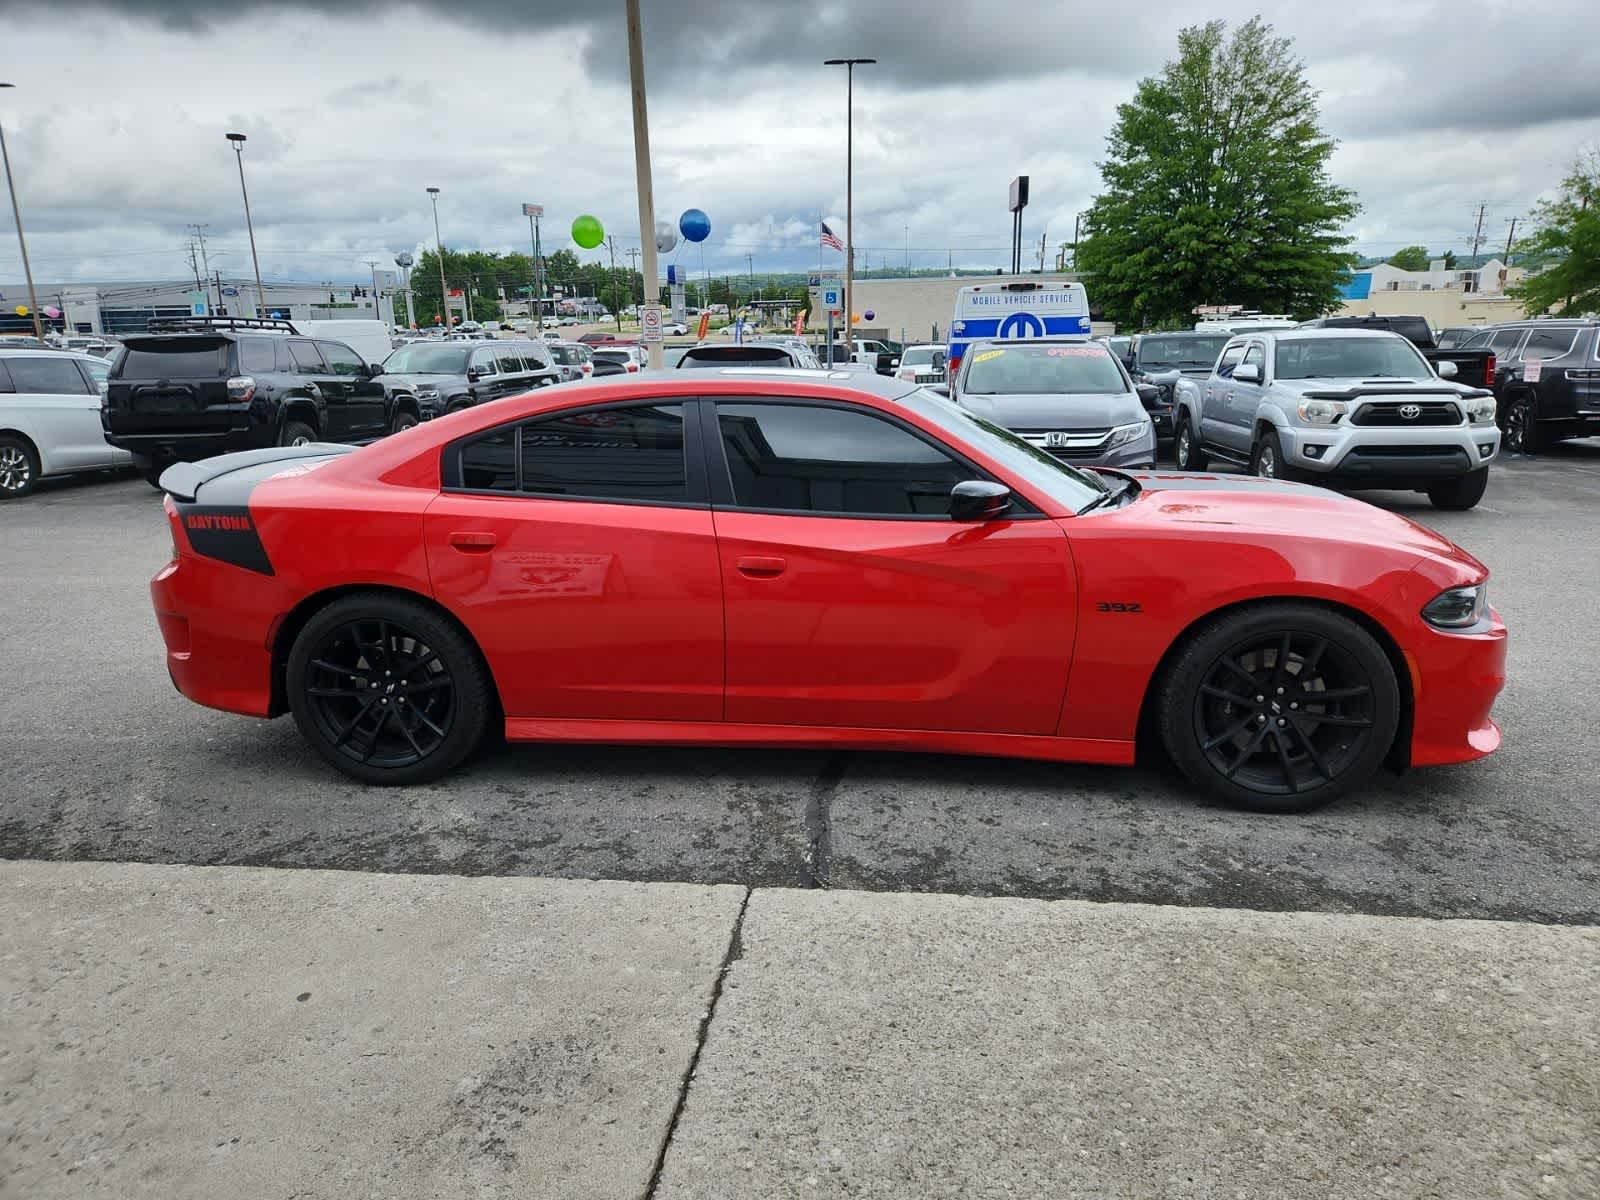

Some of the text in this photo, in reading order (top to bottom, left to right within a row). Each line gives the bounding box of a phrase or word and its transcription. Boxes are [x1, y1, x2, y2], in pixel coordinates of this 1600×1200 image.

[972, 294, 1073, 305] MOBILE VEHICLE SERVICE
[187, 515, 250, 530] DAYTONA
[1096, 602, 1144, 613] 392
